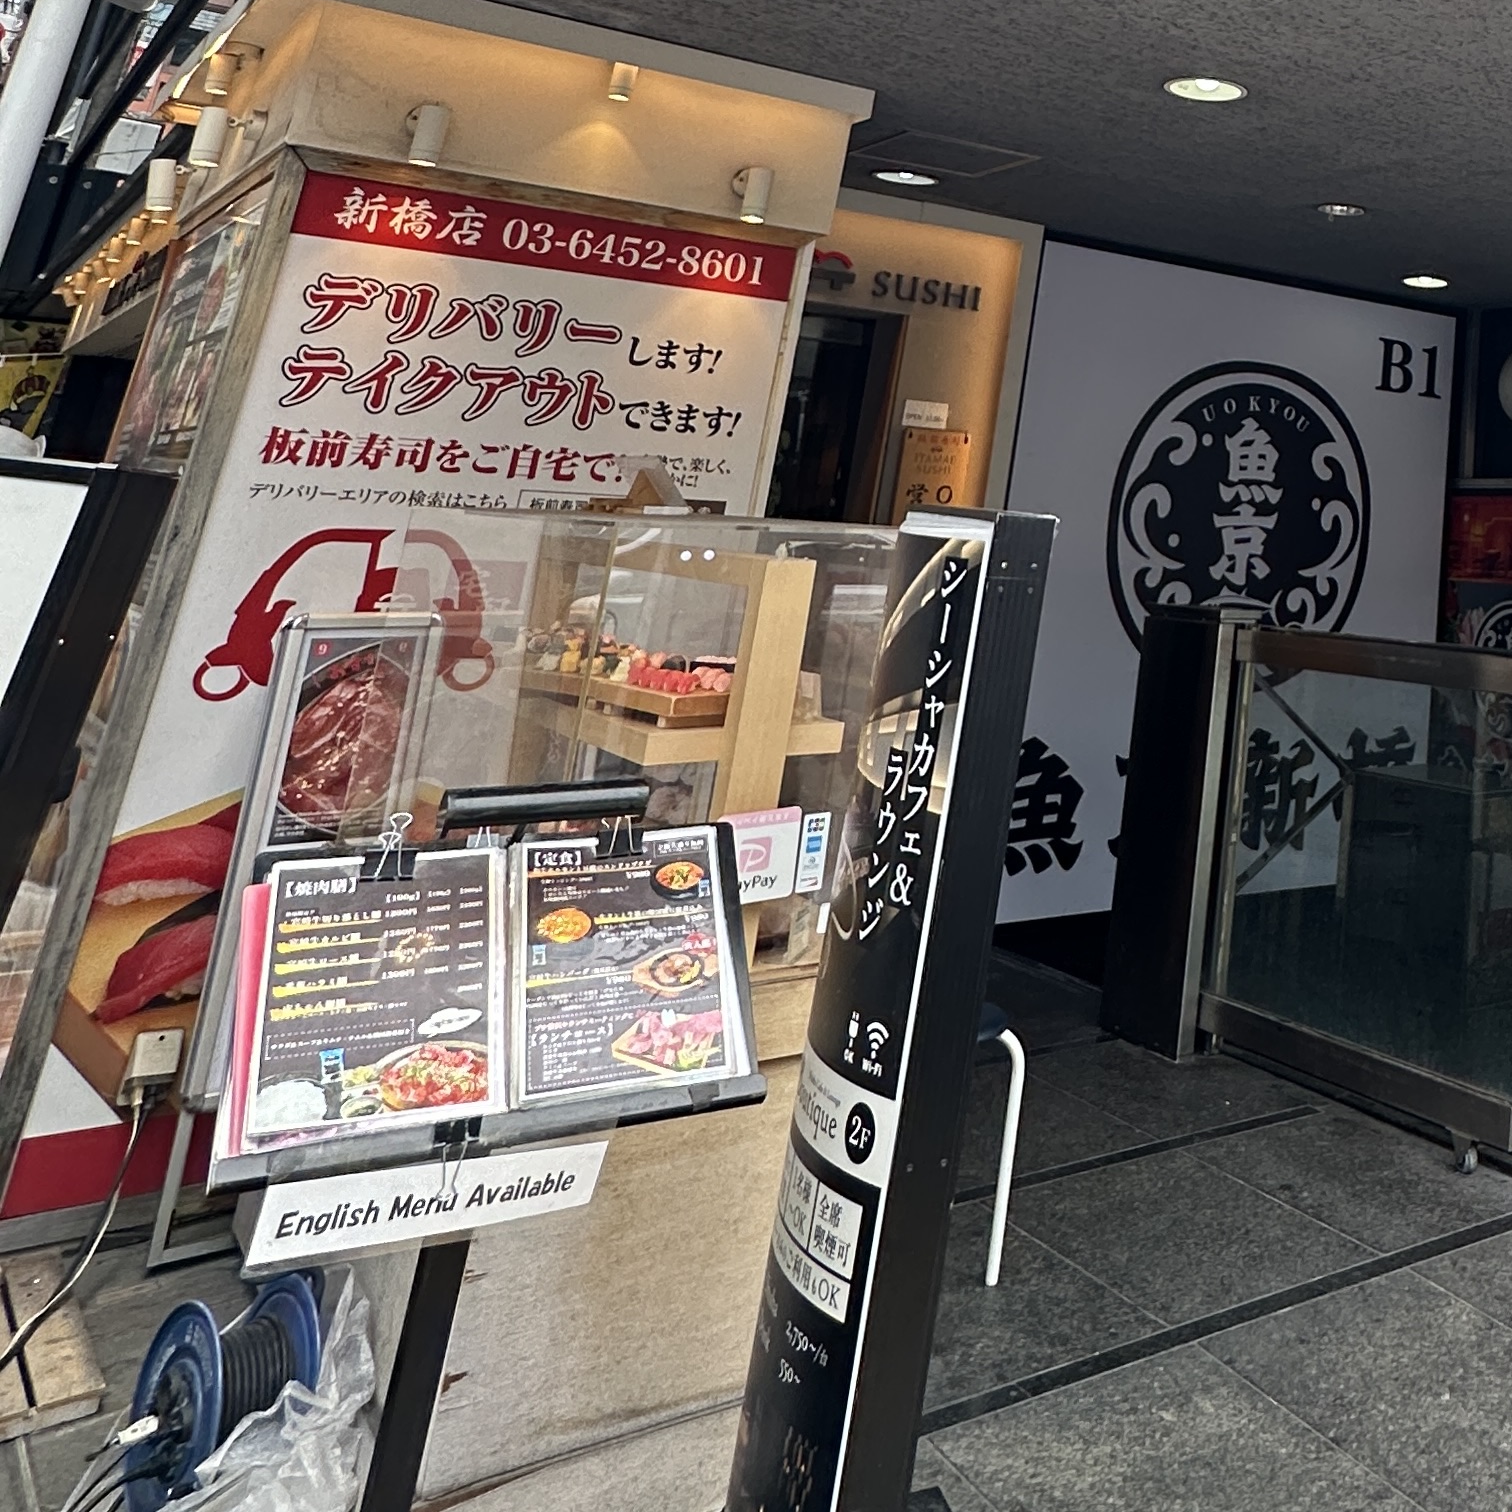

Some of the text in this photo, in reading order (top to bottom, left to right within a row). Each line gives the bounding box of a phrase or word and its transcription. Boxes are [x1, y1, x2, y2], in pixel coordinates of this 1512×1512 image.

[334, 186, 765, 286] 新橋店 03-6452-8601
[871, 270, 982, 312] SUSHI
[1375, 337, 1442, 399] B1
[249, 481, 508, 510] デリバリーエリアの検索はこちら
[1210, 416, 1282, 584] 魚京
[890, 561, 967, 905] シーシャカフェ&
[859, 754, 904, 941] ラウンジ
[738, 875, 777, 893] yPay
[848, 1114, 872, 1150] 2F
[276, 1171, 576, 1239] English Menu Available
[817, 1193, 843, 1229] 全席
[814, 1224, 851, 1269] 喫煙可
